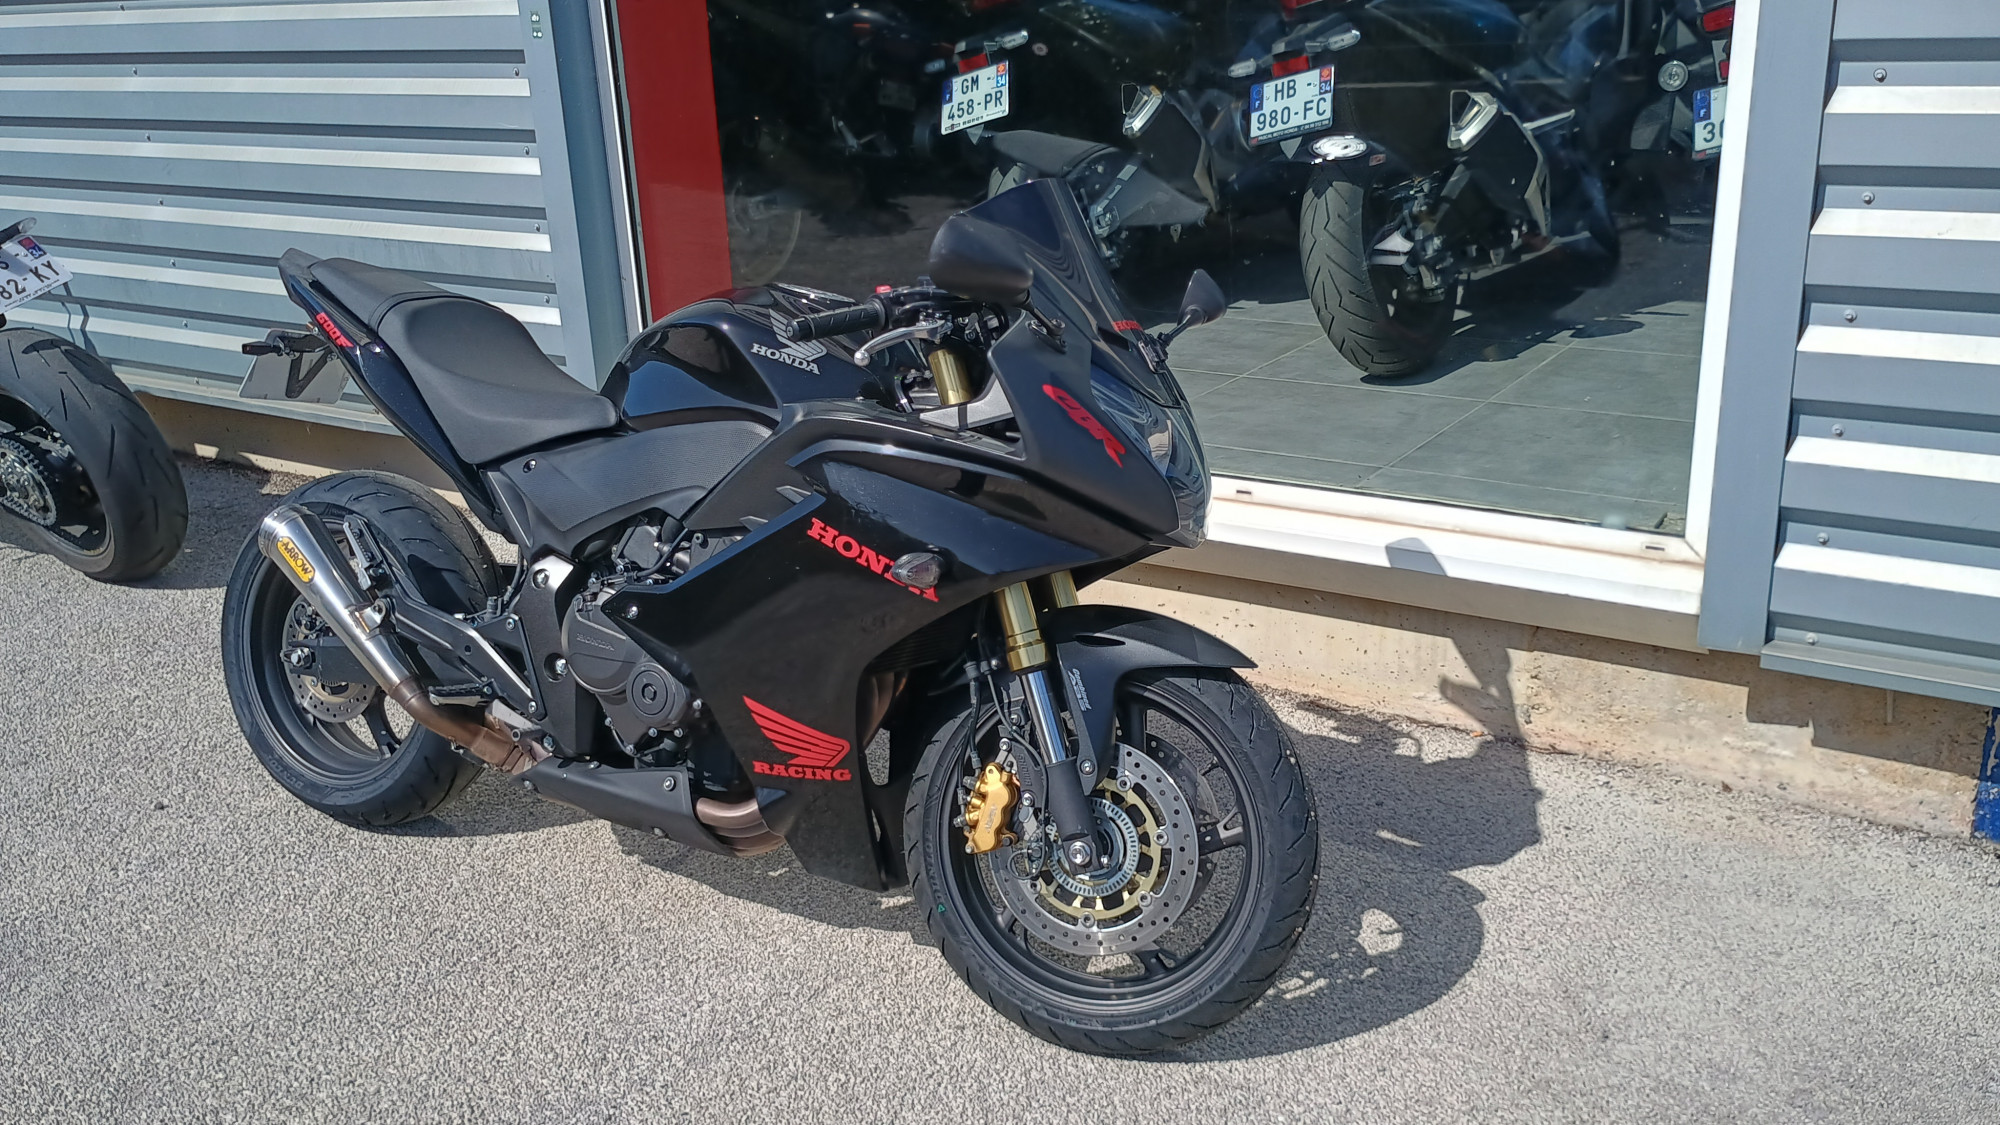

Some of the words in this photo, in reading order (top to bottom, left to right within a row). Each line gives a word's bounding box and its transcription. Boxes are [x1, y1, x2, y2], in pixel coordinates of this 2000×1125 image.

[961, 74, 979, 95] GM
[997, 75, 1005, 86] 34
[1274, 79, 1297, 102] HB
[1320, 81, 1331, 92] 34
[947, 90, 1003, 121] 458-PR
[1255, 101, 1260, 109] F
[1257, 97, 1326, 131] 980-FC
[1700, 108, 1707, 117] F
[29, 246, 44, 259] 34
[315, 311, 355, 347] 600F
[750, 342, 820, 375] HONDA
[1042, 384, 1126, 468] CBR
[281, 541, 312, 574] ARROW
[752, 760, 852, 781] RACING
